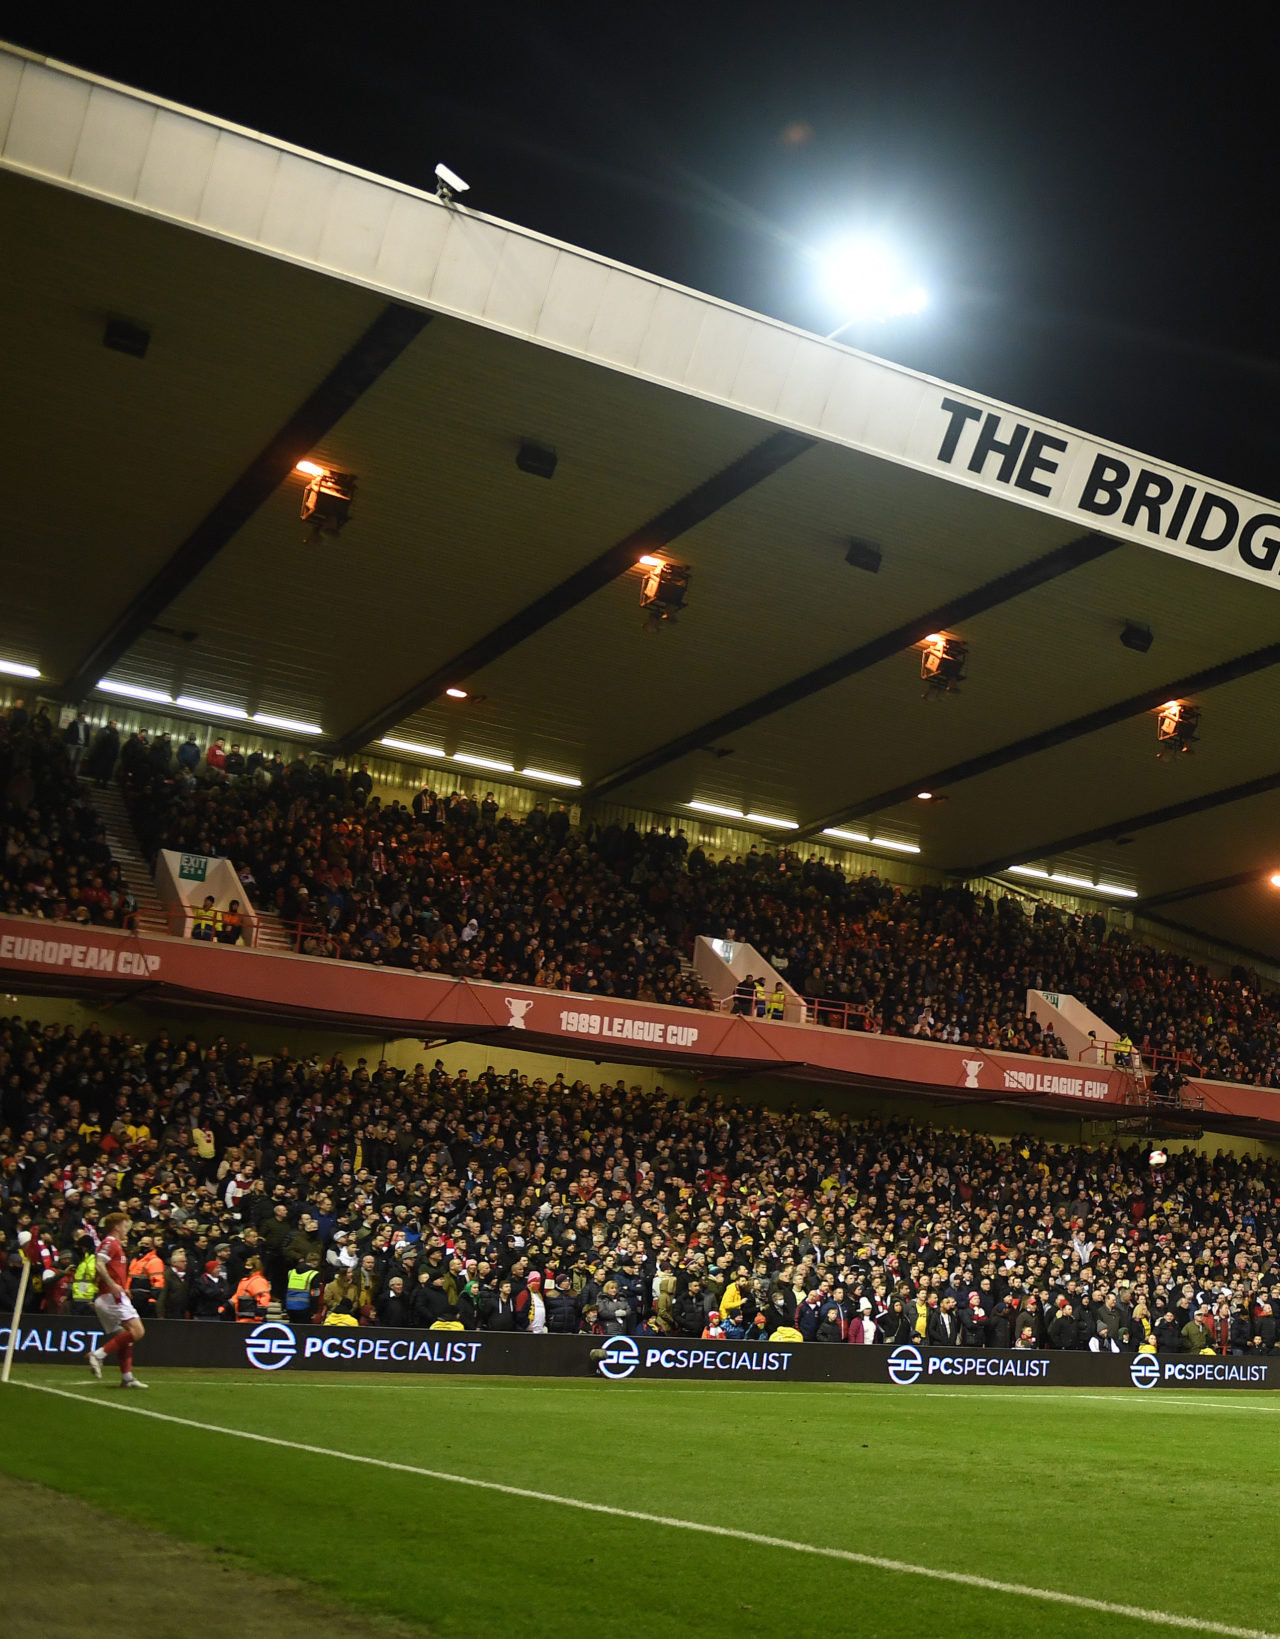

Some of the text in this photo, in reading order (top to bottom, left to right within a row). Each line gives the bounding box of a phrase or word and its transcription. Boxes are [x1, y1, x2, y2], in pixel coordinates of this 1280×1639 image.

[937, 397, 1069, 498] THE
[181, 855, 207, 869] EXIT
[0, 935, 161, 976] EUROPEAN CUP
[560, 1010, 698, 1047] 1989 LEAGUE CUP
[1036, 1074, 1083, 1097] LEAGUE
[1084, 1080, 1108, 1100] CUP
[305, 1337, 482, 1363] PCSPECIALIST
[646, 1349, 792, 1371] PCSPECIALIST
[928, 1357, 1050, 1377] PCSPECIALIST
[1164, 1363, 1267, 1381] PCSPECIALIST
